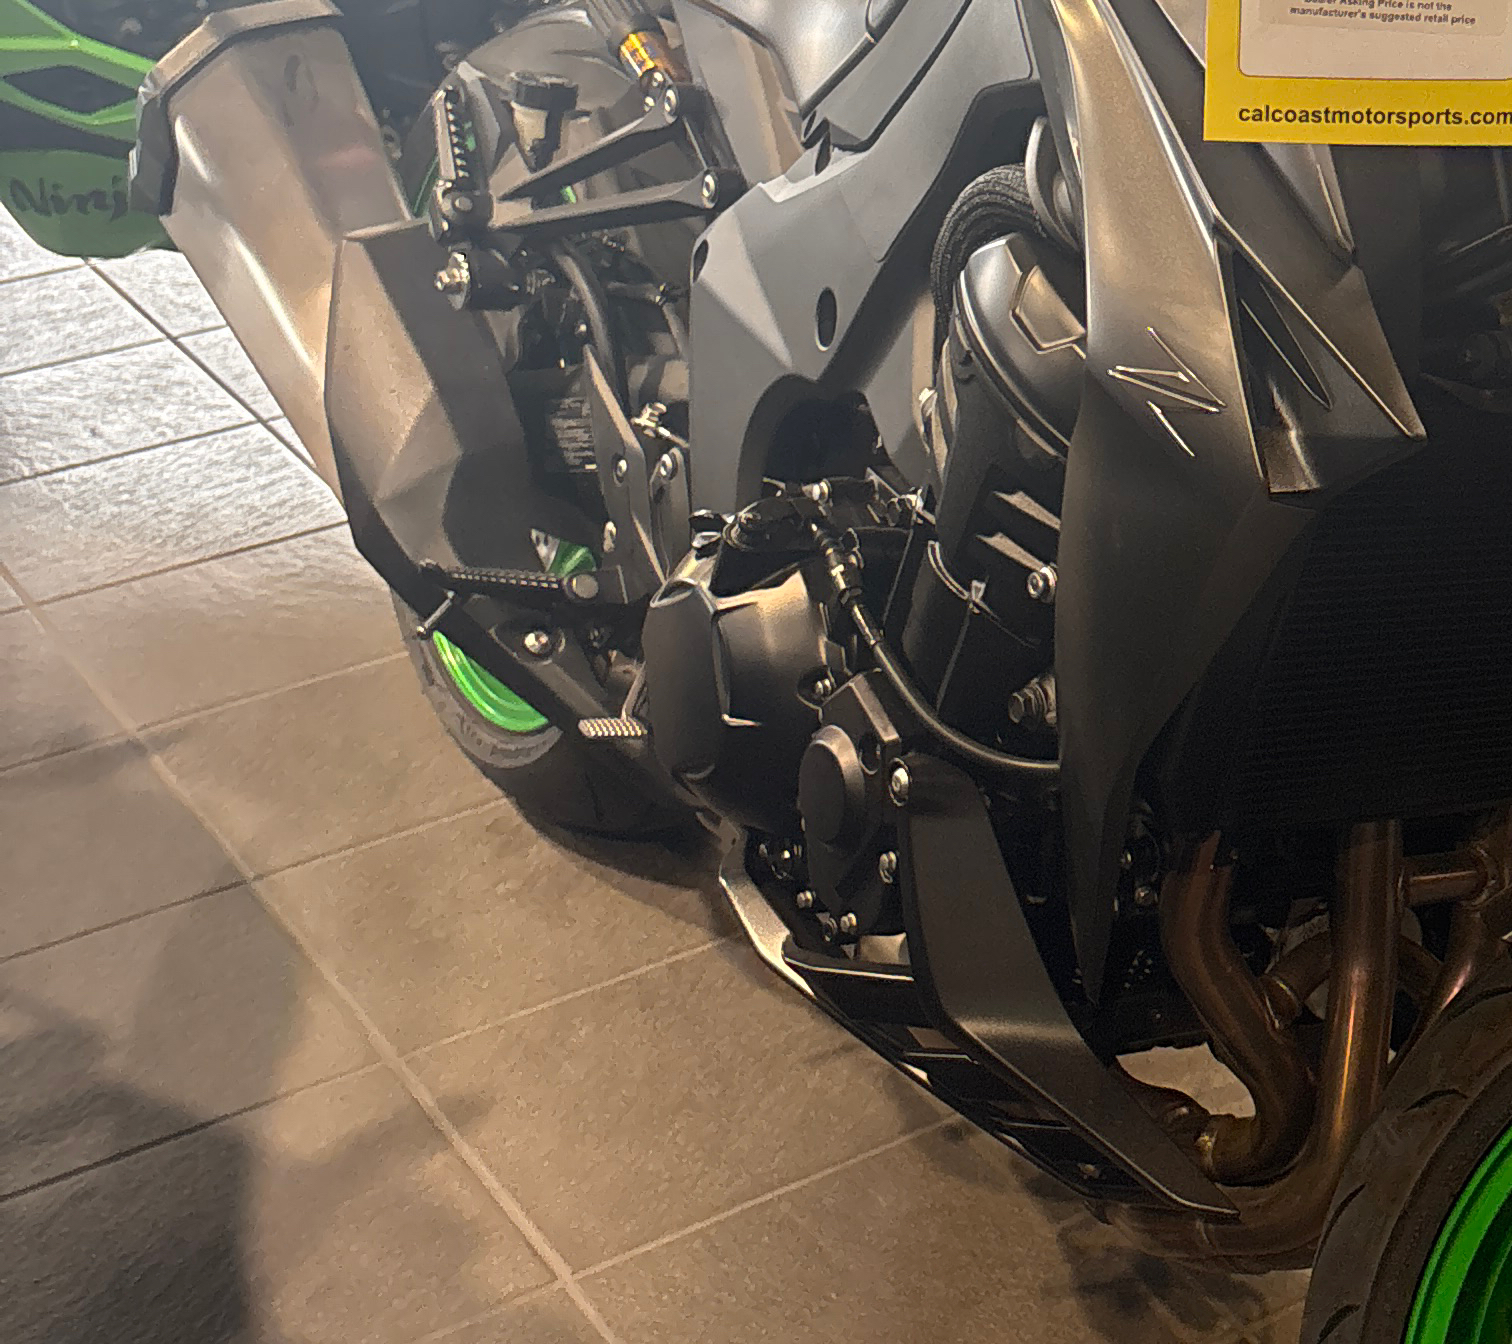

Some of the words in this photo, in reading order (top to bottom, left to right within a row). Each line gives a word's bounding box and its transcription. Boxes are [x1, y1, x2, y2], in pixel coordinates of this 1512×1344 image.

[1406, 0, 1415, 9] is
[1417, 1, 1434, 10] not
[1436, 2, 1452, 11] the
[1289, 7, 1367, 19] manufacturer's
[1369, 11, 1422, 23] suggested
[1424, 13, 1449, 23] retail
[1451, 15, 1476, 26] price
